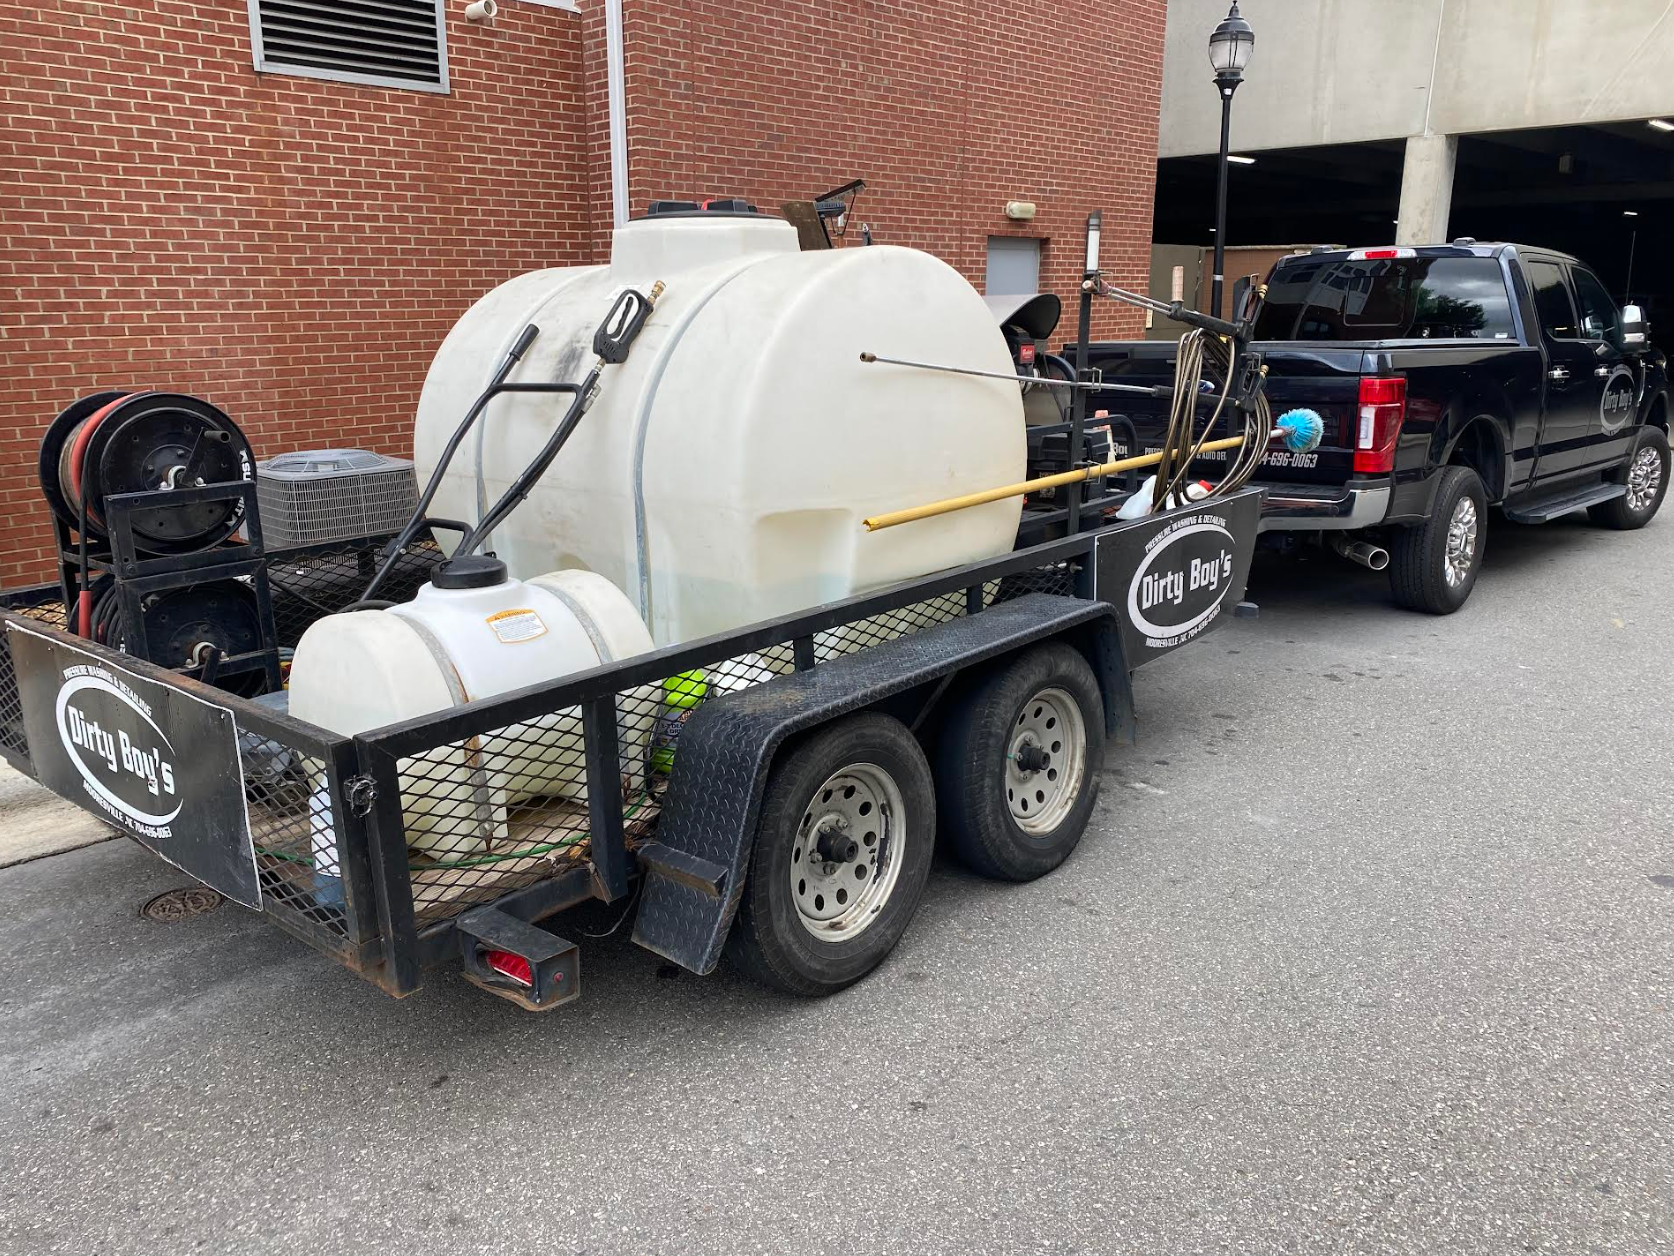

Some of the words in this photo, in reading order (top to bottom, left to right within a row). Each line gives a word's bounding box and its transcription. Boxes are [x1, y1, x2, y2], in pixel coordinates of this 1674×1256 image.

[1604, 391, 1619, 413] Dirty
[1258, 451, 1318, 468] 4-696-0063
[1145, 525, 1172, 553] PRESSURE
[1172, 515, 1197, 532] WASHING
[1198, 514, 1204, 524] &
[1203, 514, 1227, 528] DETAILING
[1142, 571, 1184, 610] Dirty
[1190, 549, 1232, 591] Boy's
[119, 680, 153, 717] DETAILING
[68, 705, 118, 773] Dirty
[118, 729, 175, 796] Boy's
[83, 780, 124, 822] MOORESVILLE
